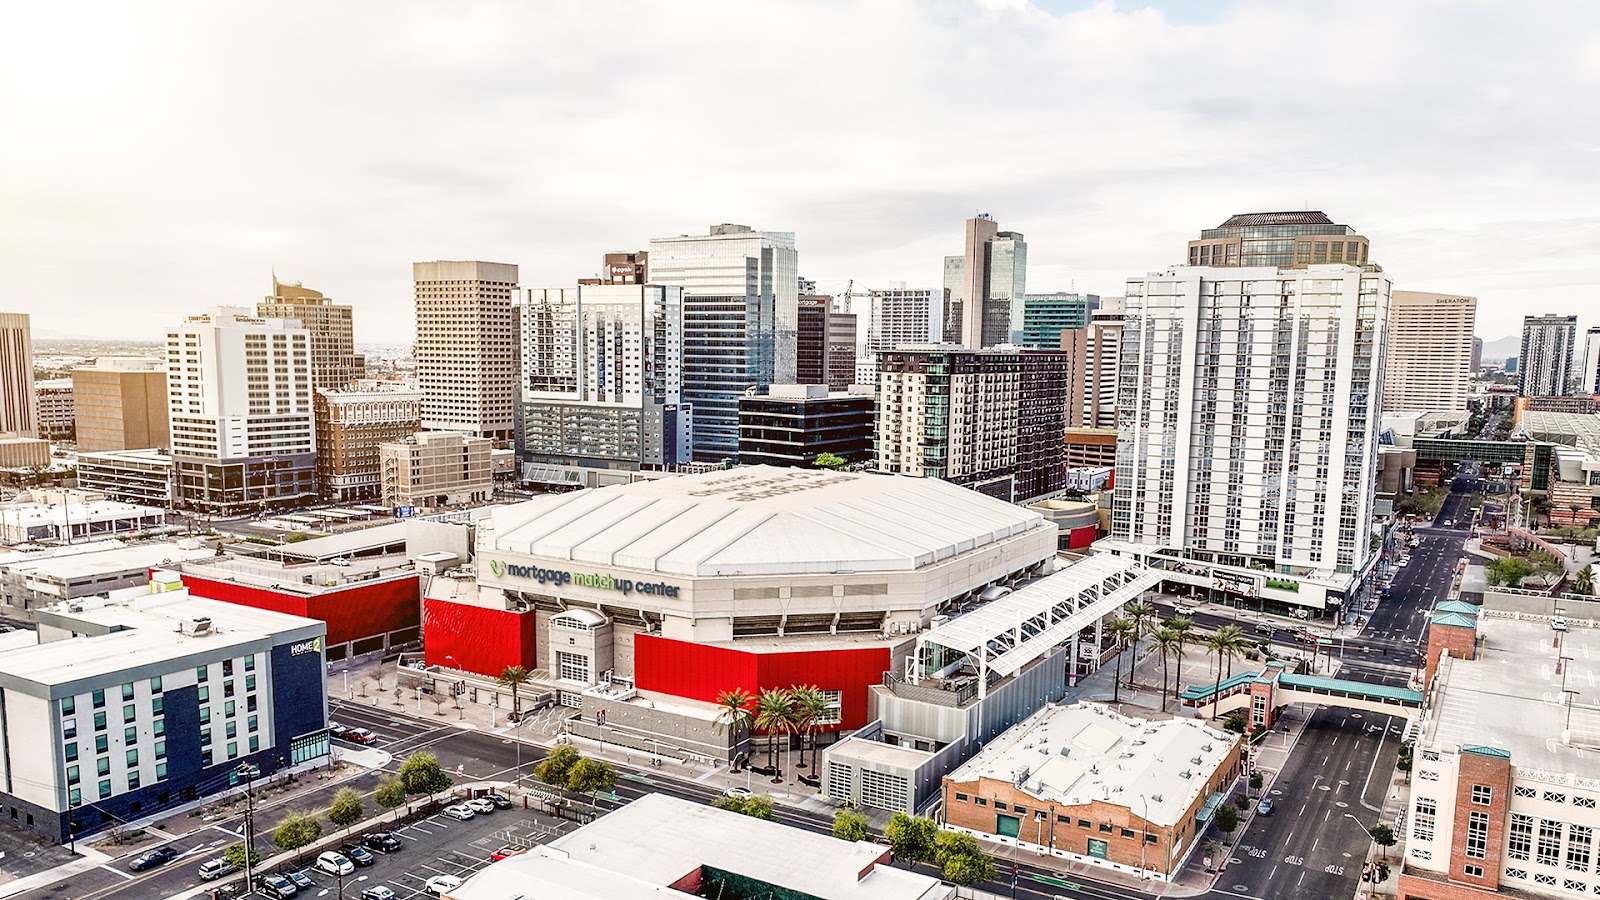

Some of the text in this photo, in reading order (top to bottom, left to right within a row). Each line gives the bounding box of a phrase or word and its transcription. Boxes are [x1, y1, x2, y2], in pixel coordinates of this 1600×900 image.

[508, 563, 680, 598] mortgage matchup center
[1248, 847, 1267, 859] STOP
[1284, 855, 1304, 866] STOP
[1324, 864, 1345, 876] STOP
